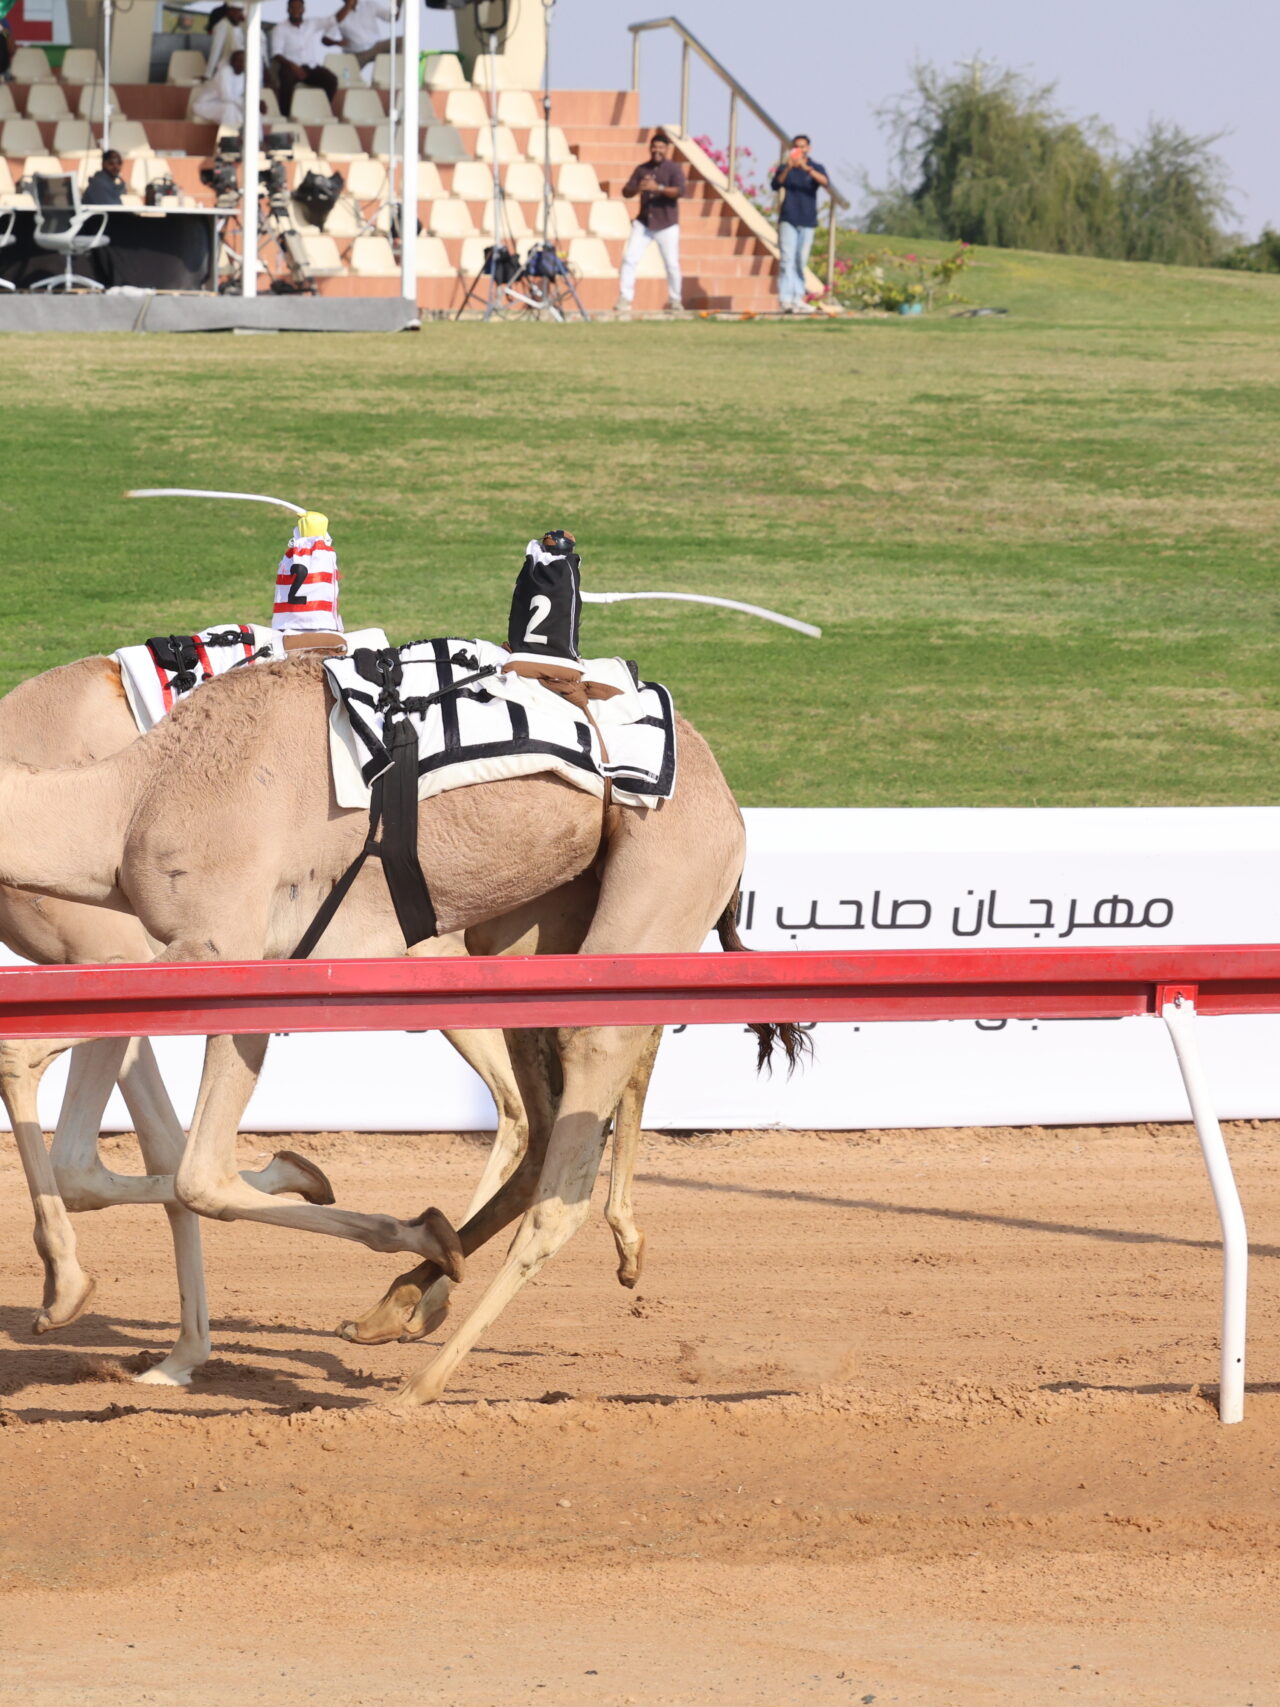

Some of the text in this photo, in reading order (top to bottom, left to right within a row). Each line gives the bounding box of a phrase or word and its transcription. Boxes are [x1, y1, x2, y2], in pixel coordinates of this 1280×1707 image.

[287, 564, 308, 605] 2
[523, 595, 552, 644] 2
[775, 890, 932, 940] صاحب
[952, 889, 1174, 938] مهرجان
